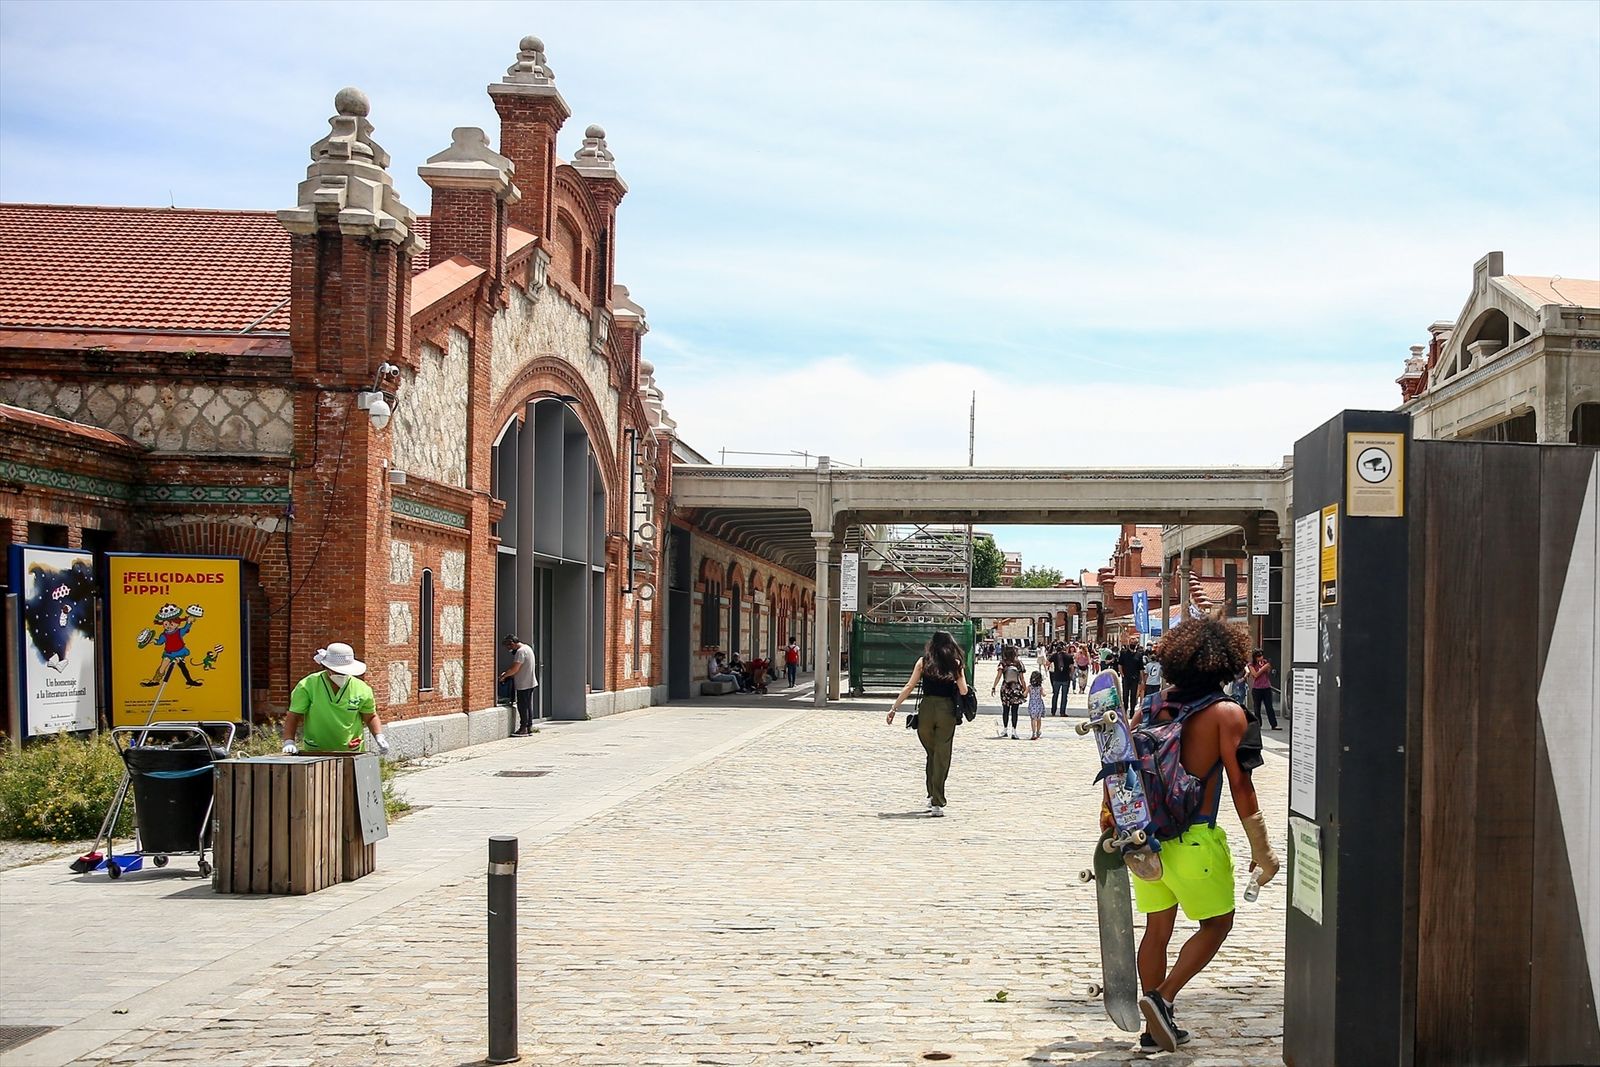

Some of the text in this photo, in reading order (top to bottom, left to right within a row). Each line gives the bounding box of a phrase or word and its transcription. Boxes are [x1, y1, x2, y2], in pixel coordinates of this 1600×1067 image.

[638, 426, 659, 600] AUDITORIO
[123, 572, 224, 584] ¡FELICIDADES
[123, 585, 170, 595] PIPPI!
[46, 678, 77, 688] Un homenaje
[46, 689, 67, 698] literatura
[69, 687, 87, 696] infantil
